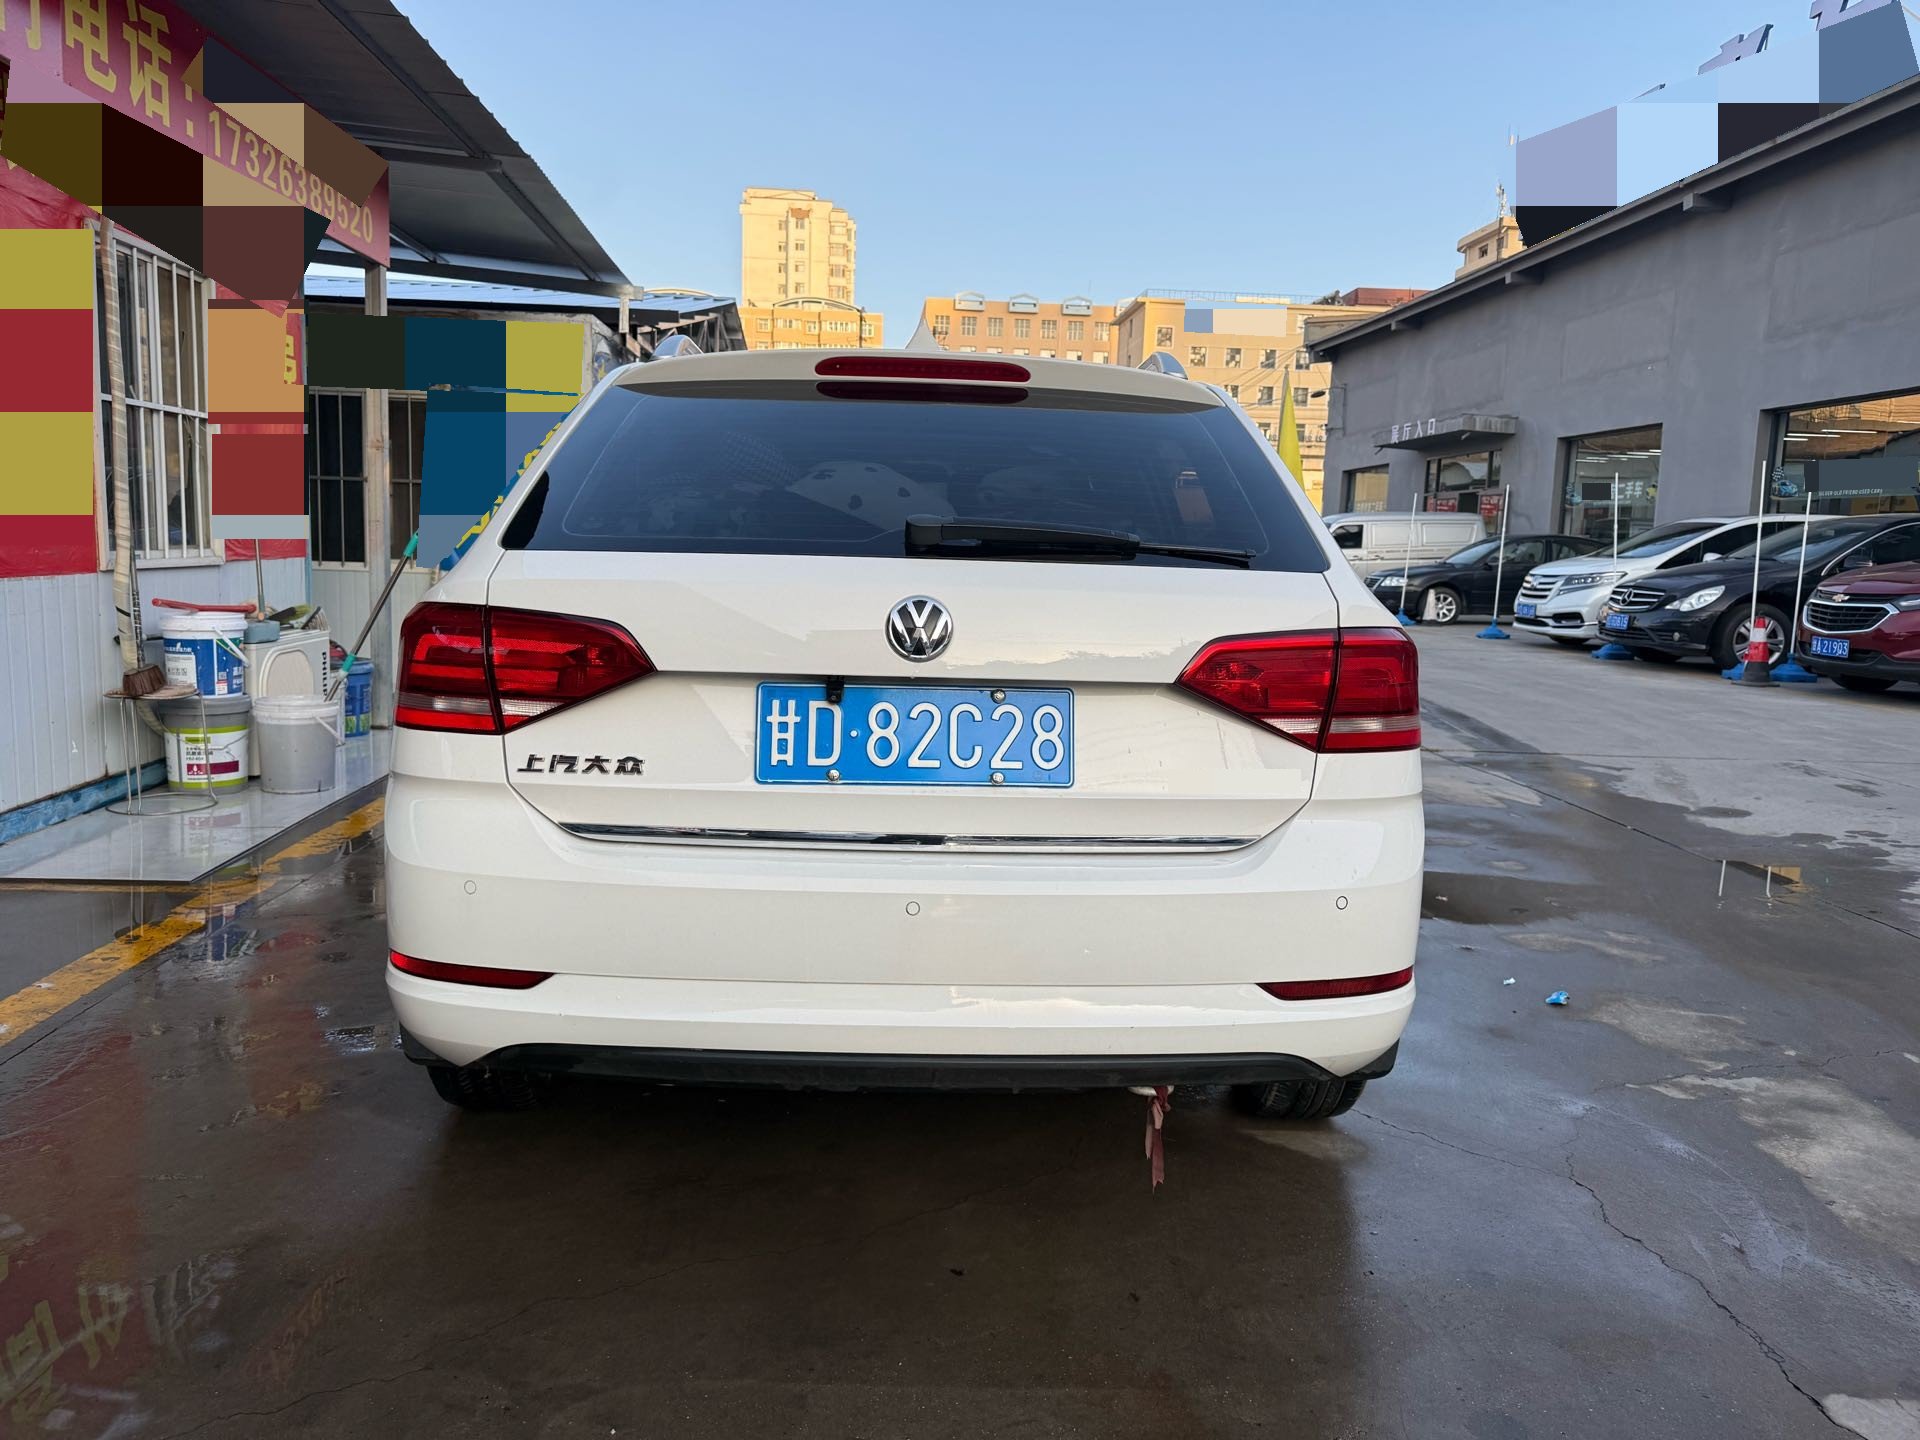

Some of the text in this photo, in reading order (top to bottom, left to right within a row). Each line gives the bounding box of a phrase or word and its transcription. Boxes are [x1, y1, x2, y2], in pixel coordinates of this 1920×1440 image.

[208, 110, 373, 243] 17326389520
[1391, 418, 1436, 443] 展厅入口
[516, 754, 645, 775] 上汽大众
